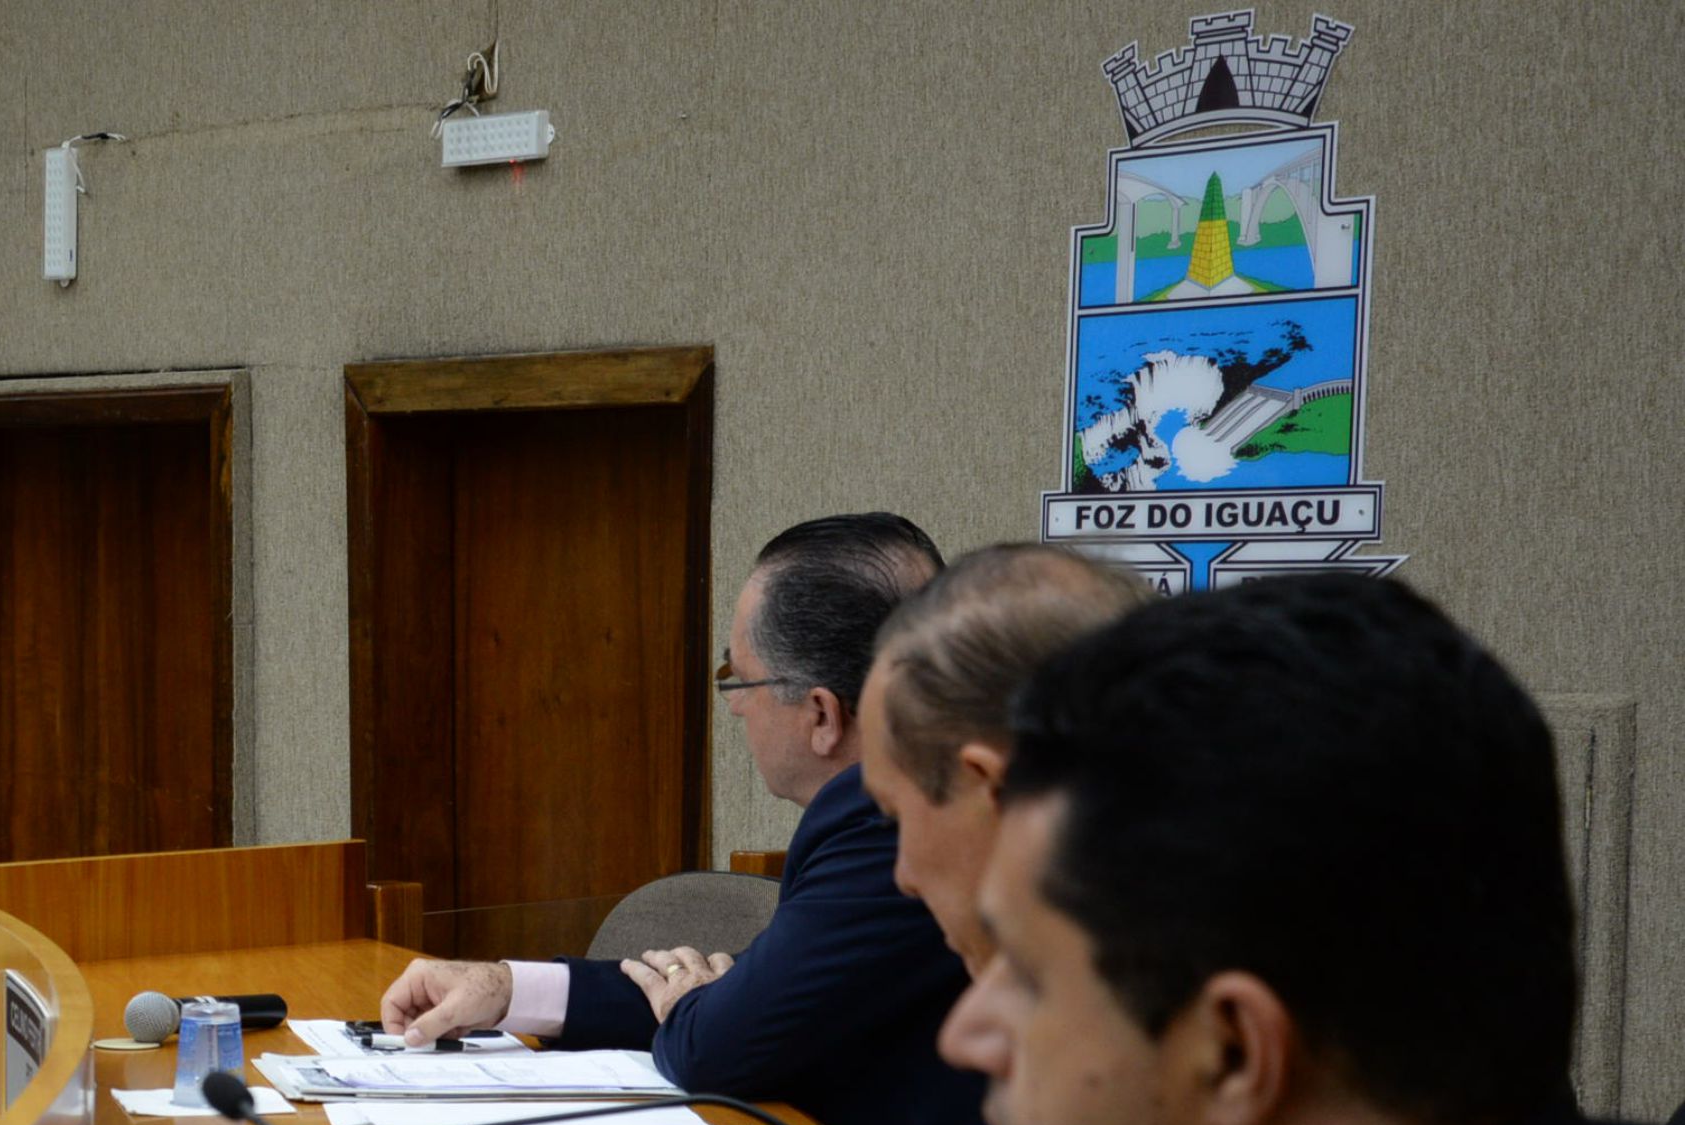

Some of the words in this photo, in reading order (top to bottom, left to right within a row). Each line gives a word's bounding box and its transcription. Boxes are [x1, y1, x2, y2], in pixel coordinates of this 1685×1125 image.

[1075, 504, 1136, 530] FOZ
[1147, 502, 1192, 529] DO
[1205, 500, 1341, 534] IGUAÇU
